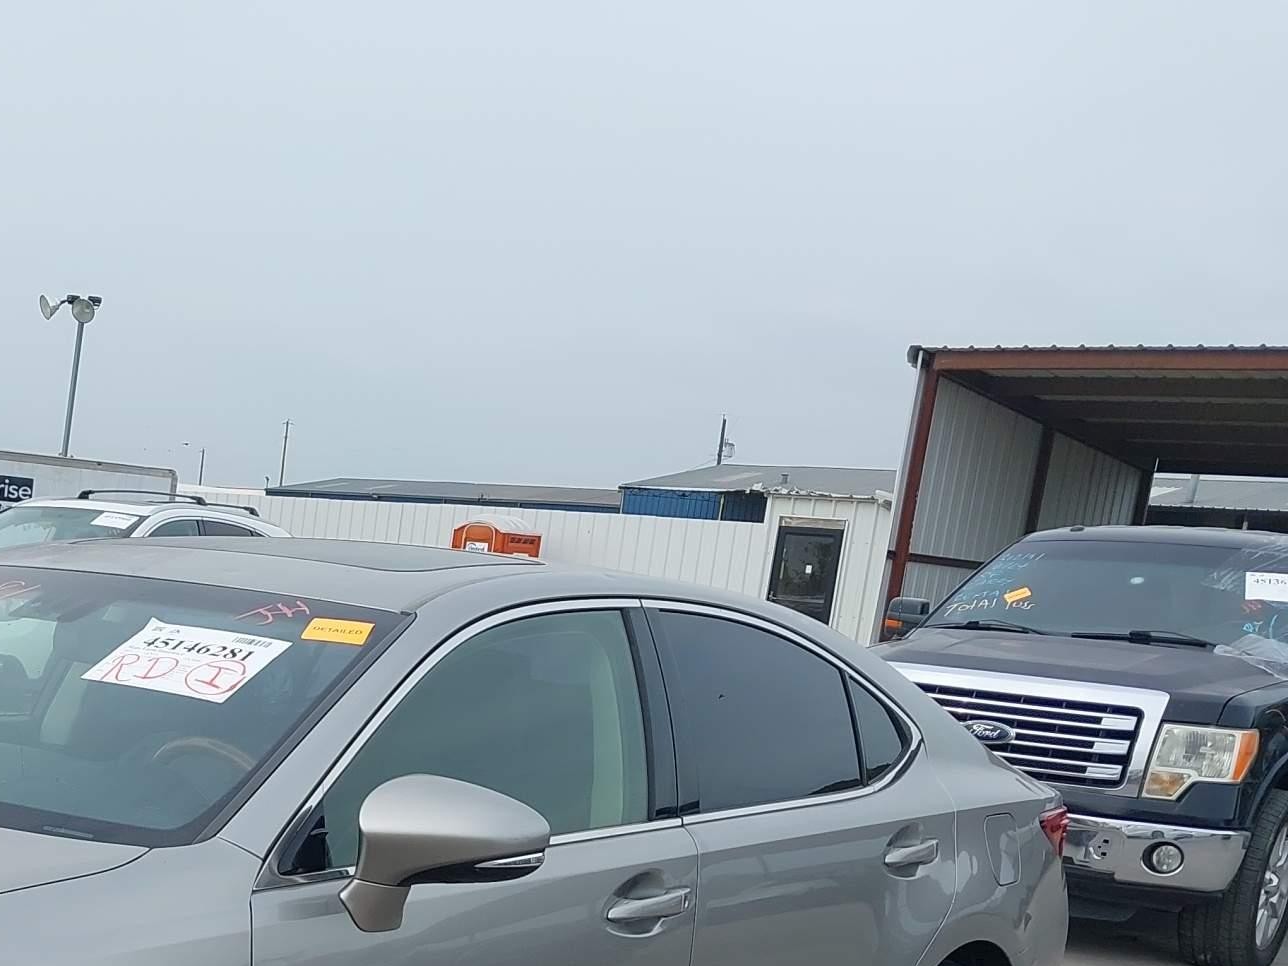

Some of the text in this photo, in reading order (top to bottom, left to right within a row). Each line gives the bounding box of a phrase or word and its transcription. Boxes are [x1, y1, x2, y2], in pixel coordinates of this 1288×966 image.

[313, 626, 363, 636] DETAILED
[144, 637, 255, 662] 45146281
[969, 723, 1001, 738] Ford
